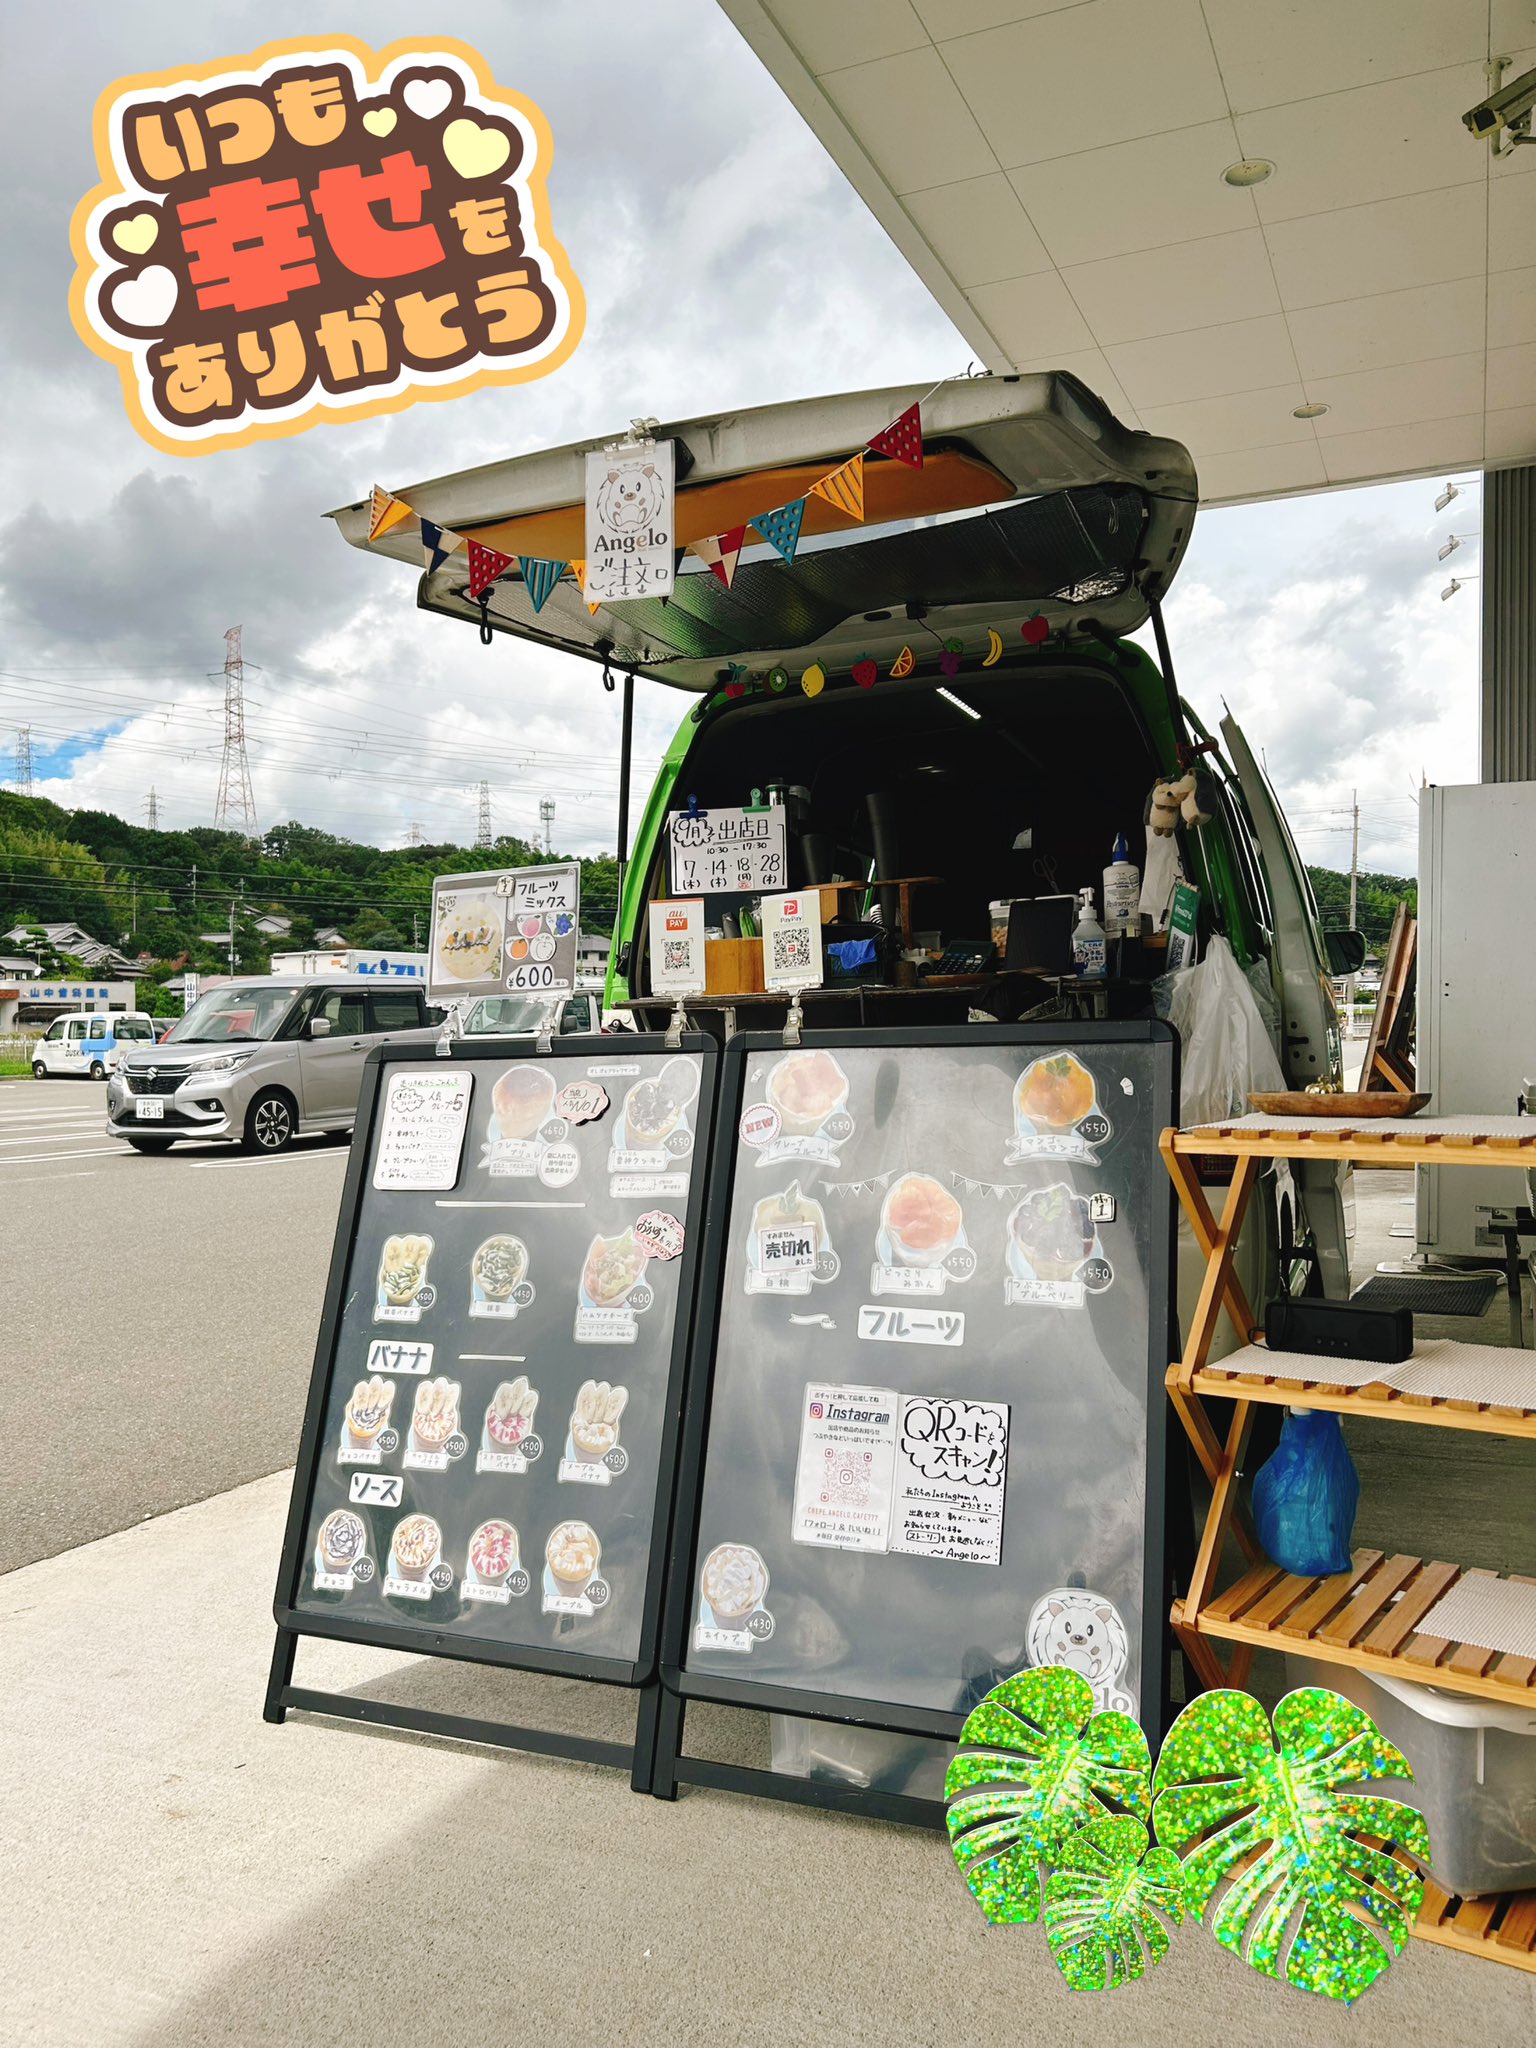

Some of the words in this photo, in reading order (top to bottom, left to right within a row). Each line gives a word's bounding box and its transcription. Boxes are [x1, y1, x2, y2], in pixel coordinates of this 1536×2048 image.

[594, 528, 668, 553] Angelo
[590, 557, 668, 590] ご注文口
[678, 819, 701, 839] 9月
[718, 816, 769, 840] 出店日
[707, 847, 728, 855] 10:30
[742, 842, 767, 851] 17:30
[712, 860, 727, 875] 14
[737, 857, 750, 871] 18
[760, 853, 780, 872] 28
[518, 880, 558, 896] フルーツ
[525, 896, 566, 908] ミックス
[668, 909, 685, 918] au
[669, 919, 684, 927] PAY
[780, 916, 802, 924] PayPay
[508, 965, 553, 988] ¥600
[30, 987, 109, 999] 山中歯科医院
[453, 1093, 464, 1111] 5
[745, 1116, 774, 1134] NEW
[827, 1120, 850, 1131] ¥550
[1080, 1122, 1107, 1133] ¥550
[668, 1137, 690, 1147] ¥550
[774, 1139, 805, 1148] グレープ
[1026, 1136, 1061, 1145] マンゴー
[510, 1149, 540, 1159] ブリュレ
[794, 1147, 824, 1155] フルーツ
[767, 1231, 795, 1239] すみません
[765, 1239, 812, 1259] 売切れ
[795, 1258, 813, 1266] ました
[948, 1257, 972, 1268] ¥550
[1083, 1268, 1109, 1279] ¥550
[903, 1279, 935, 1288] みかん
[417, 1293, 433, 1301] ¥500
[513, 1289, 530, 1298] ¥450
[629, 1293, 651, 1303] ¥600
[1020, 1290, 1075, 1301] ブルーベリー
[863, 1310, 961, 1341] フルーツ
[371, 1345, 428, 1369] バナナ
[827, 1404, 890, 1423] Instagram
[379, 1436, 395, 1445] ¥500
[445, 1442, 464, 1451] ¥500
[521, 1442, 539, 1452] ¥500
[605, 1455, 625, 1465] ¥500
[933, 1445, 998, 1474] スキャン!
[354, 1476, 398, 1502] ソース
[946, 1547, 979, 1560] Angelo
[354, 1564, 373, 1574] ¥450
[323, 1577, 345, 1586] チョコ
[432, 1572, 451, 1582] ¥450
[508, 1576, 526, 1586] ¥450
[388, 1582, 427, 1594] キャラメル
[466, 1587, 505, 1598] ストロベリー
[587, 1587, 606, 1597] ¥450
[749, 1618, 771, 1630] ¥430
[705, 1631, 739, 1642] ホイップ
